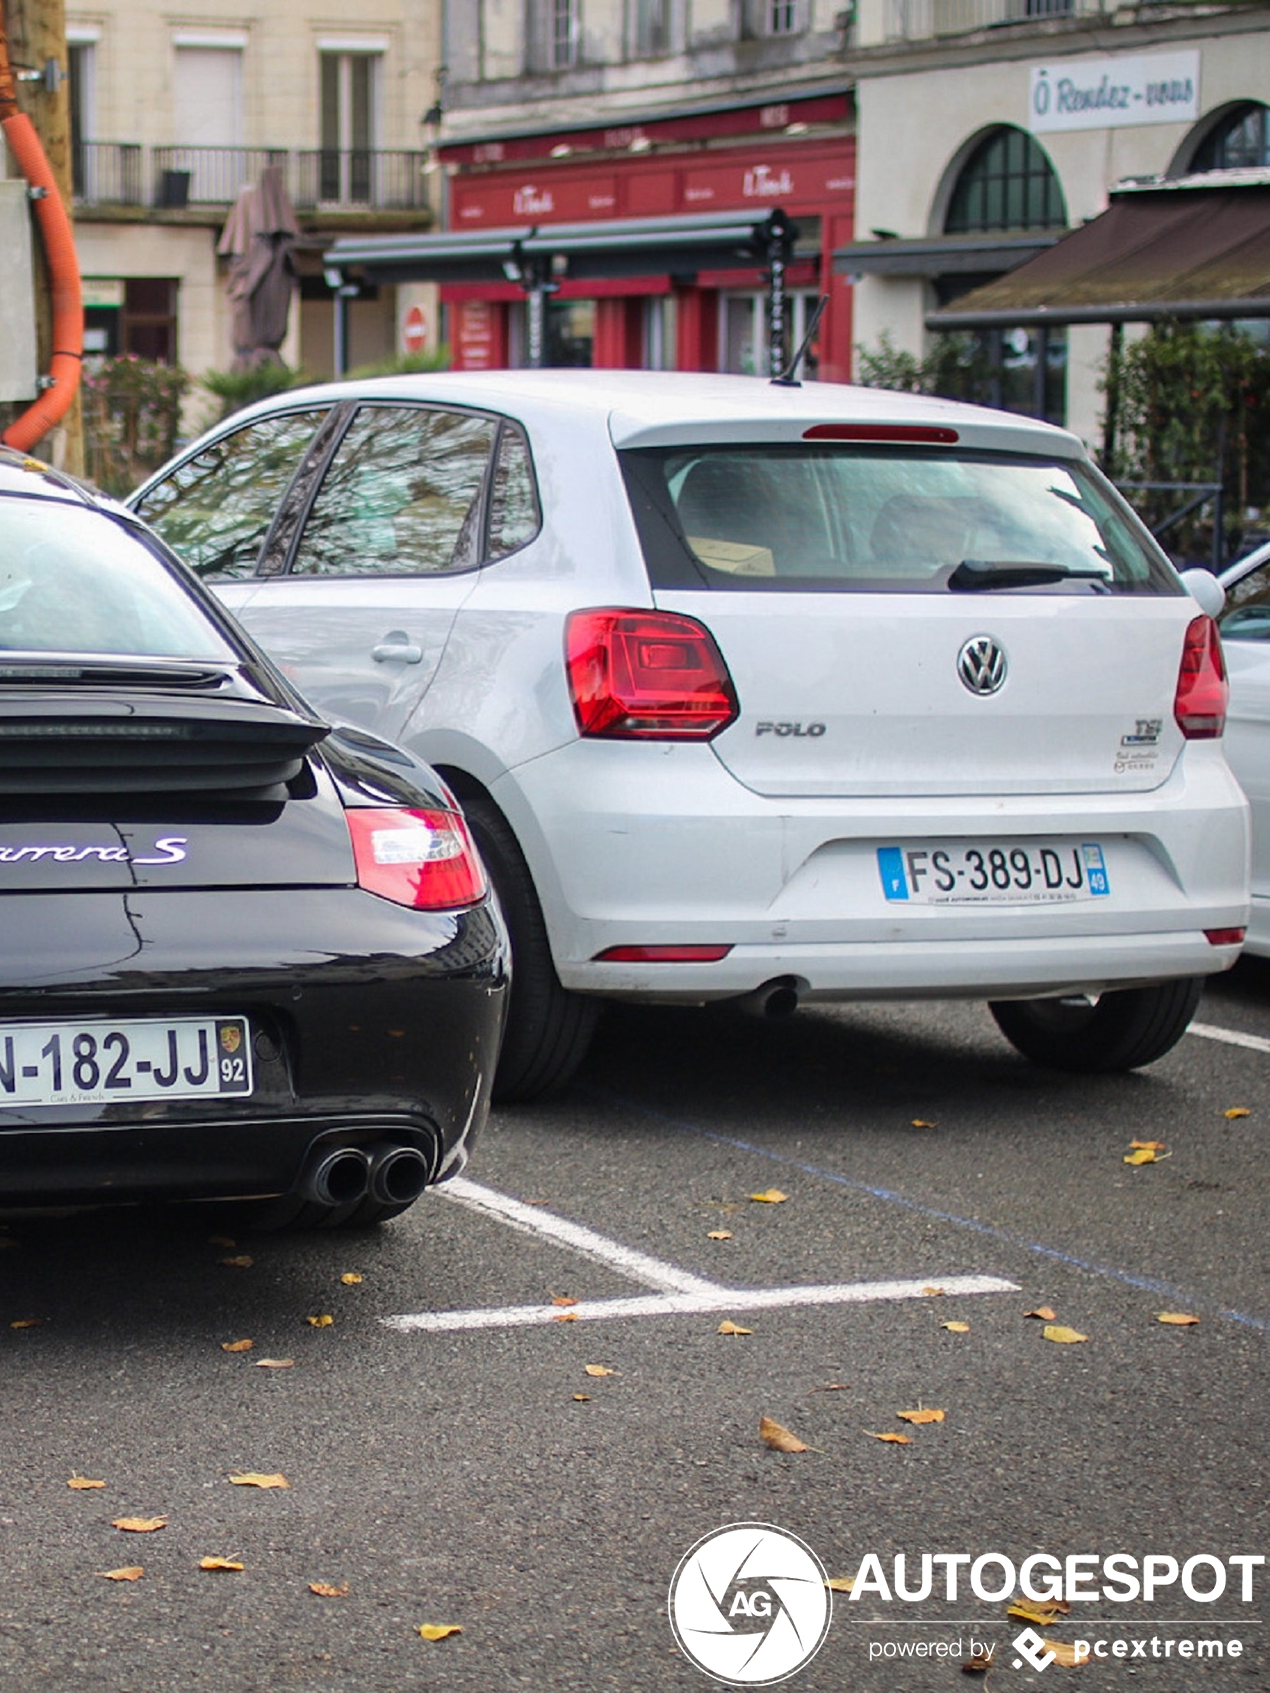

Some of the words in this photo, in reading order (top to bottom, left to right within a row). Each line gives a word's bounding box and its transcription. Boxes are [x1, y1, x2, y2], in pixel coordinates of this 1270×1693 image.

[1057, 74, 1193, 113] Rendez-vous
[756, 722, 826, 737] POLO
[130, 837, 188, 865] S
[906, 848, 1083, 893] FS-389-DJ
[1091, 872, 1106, 890] 49
[892, 878, 900, 891] F
[221, 1058, 245, 1083] 92
